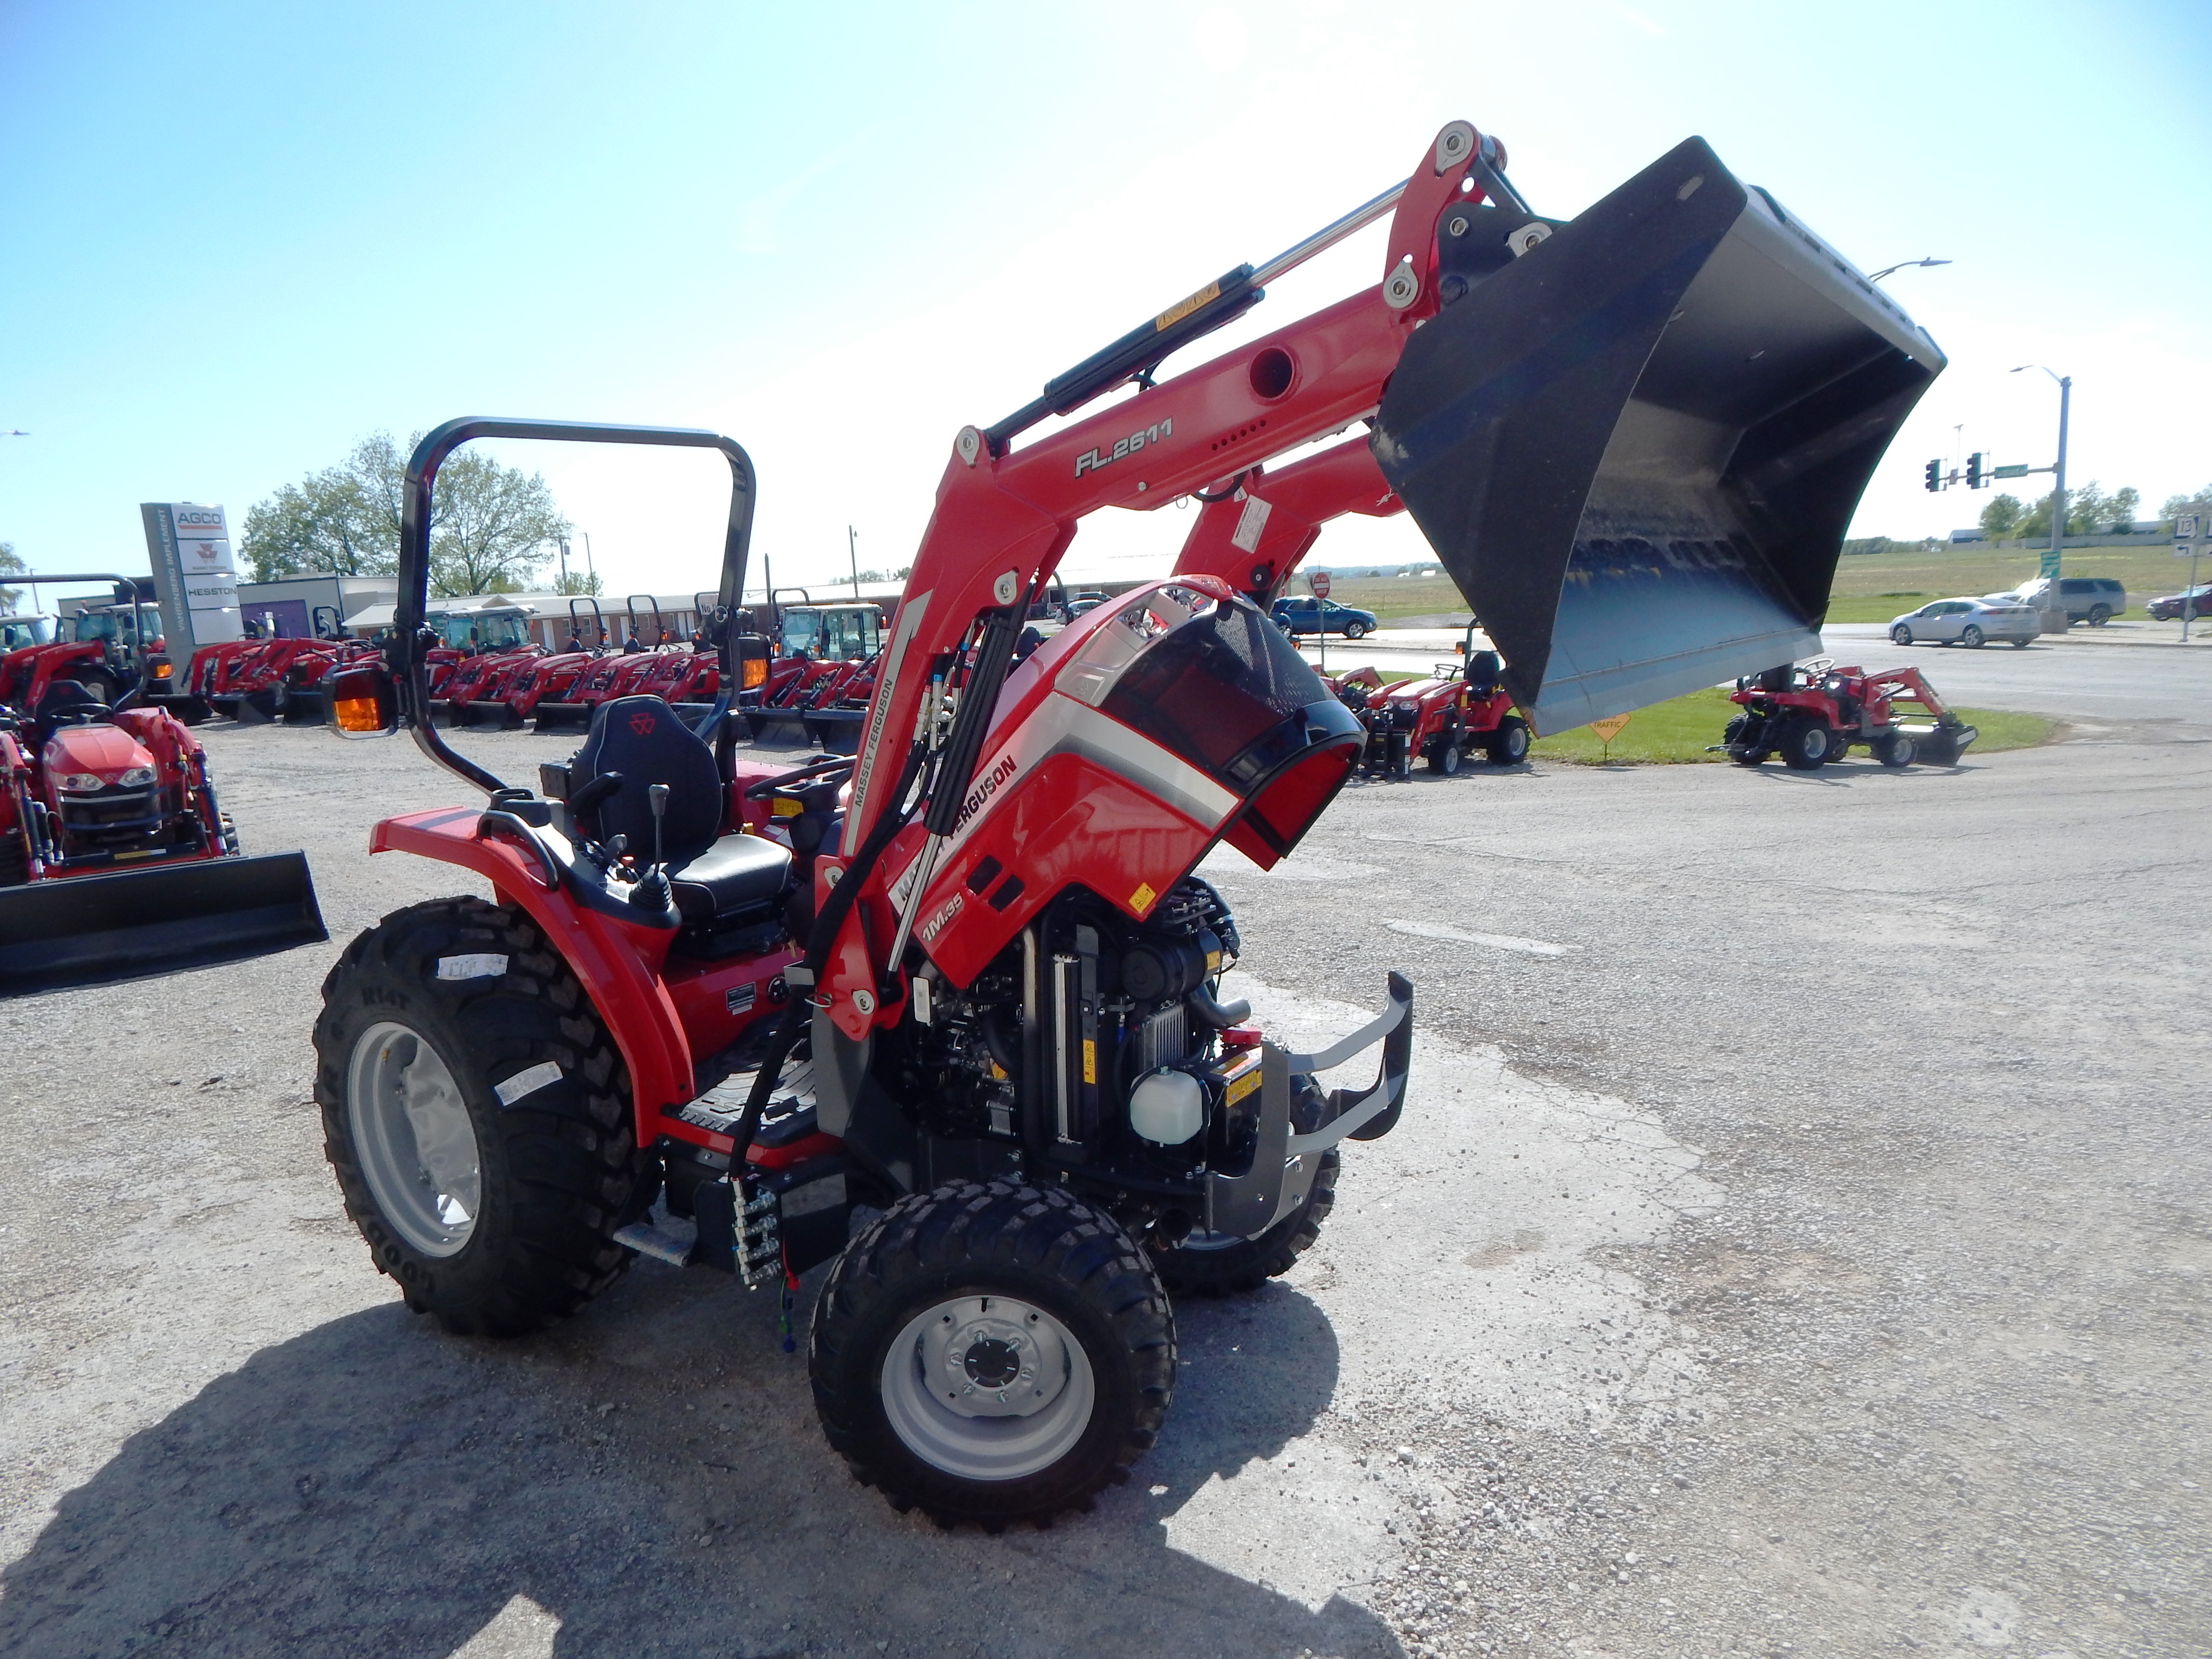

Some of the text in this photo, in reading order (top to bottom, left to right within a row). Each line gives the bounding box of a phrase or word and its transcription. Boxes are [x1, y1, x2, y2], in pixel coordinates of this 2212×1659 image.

[1075, 417, 1172, 478] FL.2611
[158, 509, 174, 565] IMPLEMENT
[178, 512, 222, 524] AGCO
[188, 587, 237, 596] HESSTON
[701, 604, 710, 613] No
[855, 678, 893, 807] MASSEY FERGUSON
[950, 754, 1017, 840] ERGUSON
[923, 891, 962, 941] 1M.35
